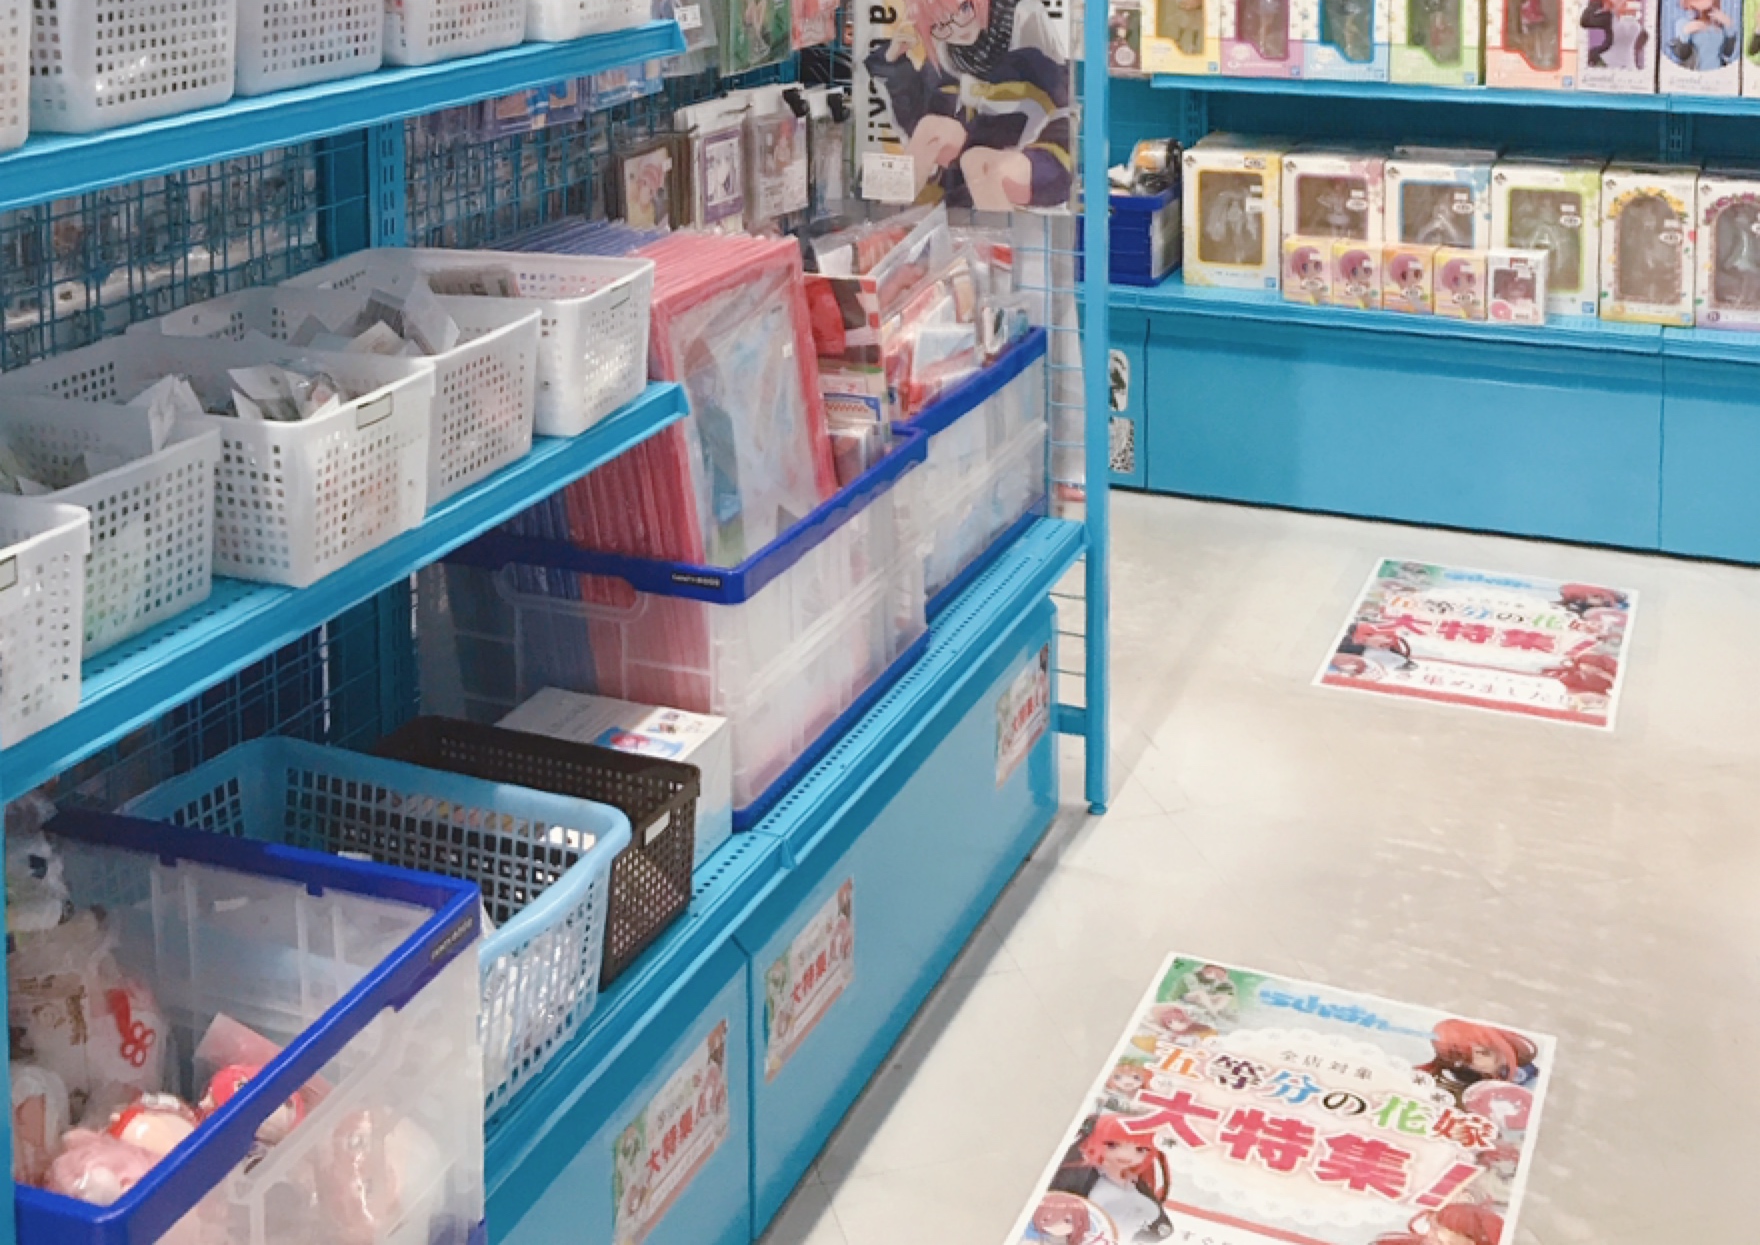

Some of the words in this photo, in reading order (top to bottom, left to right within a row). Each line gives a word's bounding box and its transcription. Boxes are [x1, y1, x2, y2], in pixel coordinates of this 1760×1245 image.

[1123, 1089, 1480, 1209] 大特集!
[1158, 1045, 1496, 1150] 五等分の花嫁
